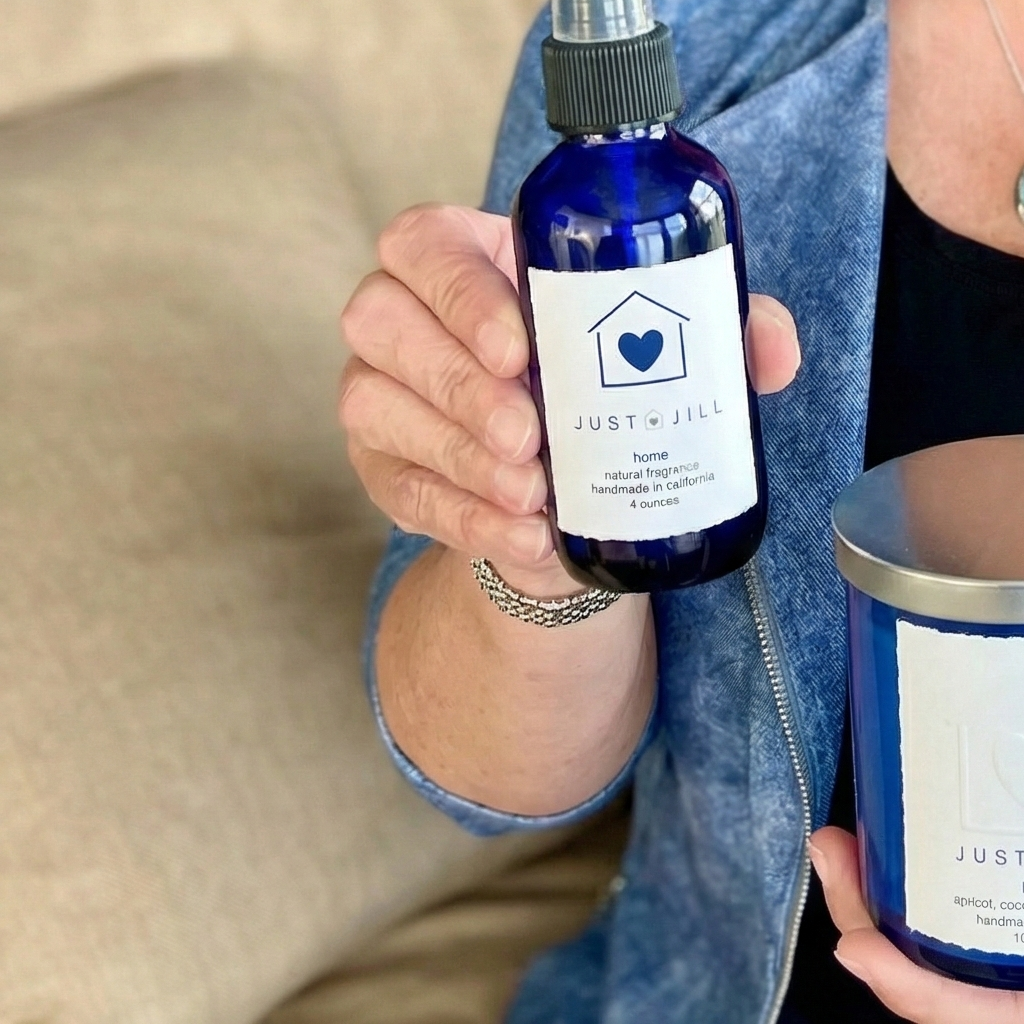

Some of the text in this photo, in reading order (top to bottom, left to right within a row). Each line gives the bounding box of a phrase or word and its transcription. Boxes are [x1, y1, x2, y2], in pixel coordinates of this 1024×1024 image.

[574, 400, 723, 431] JUST JILL
[633, 451, 669, 463] home
[604, 469, 643, 480] natural
[591, 483, 649, 494] handmade
[653, 481, 663, 492] in
[630, 496, 680, 509] 4 ounces
